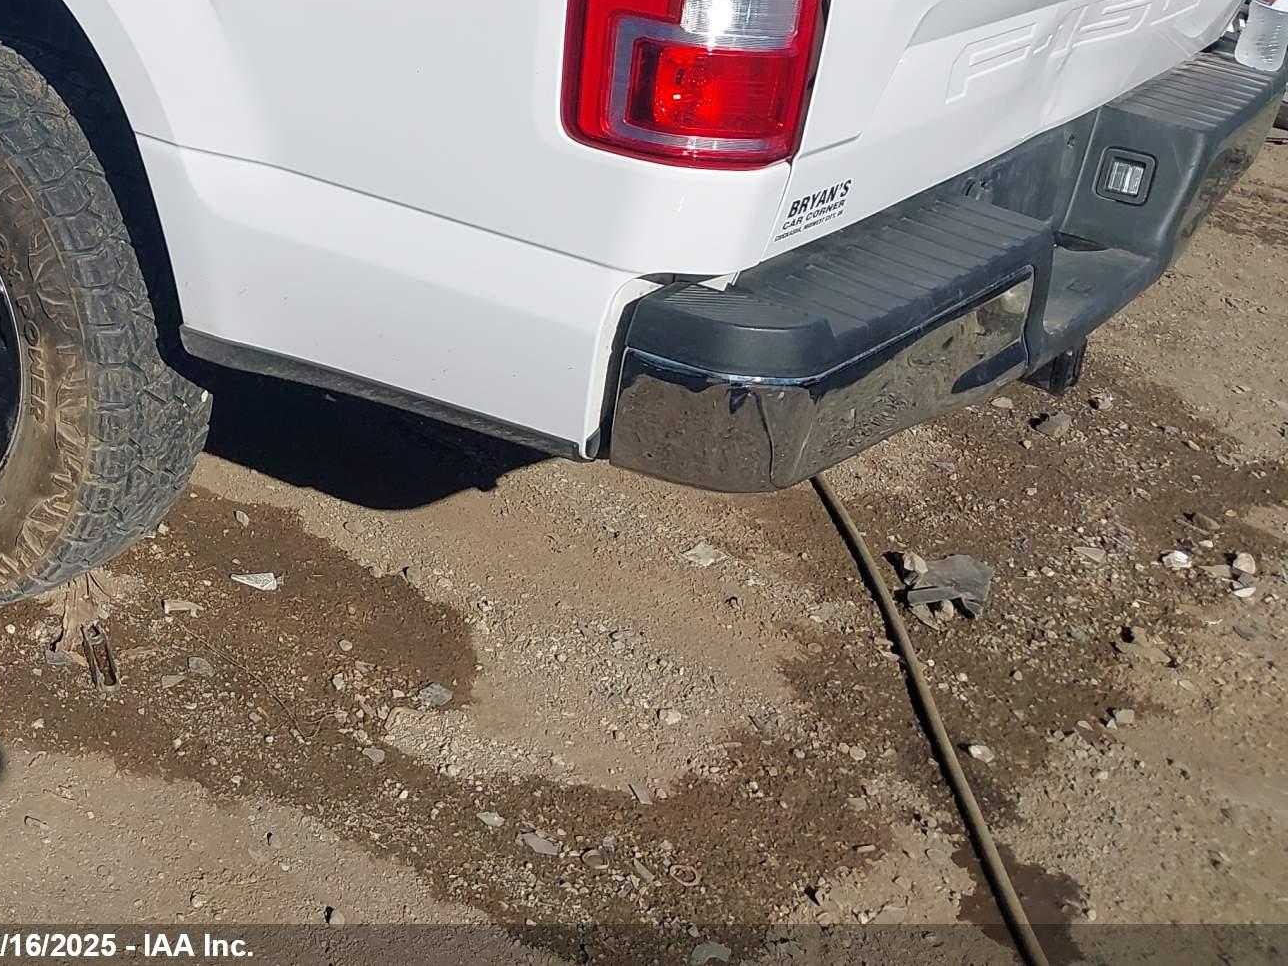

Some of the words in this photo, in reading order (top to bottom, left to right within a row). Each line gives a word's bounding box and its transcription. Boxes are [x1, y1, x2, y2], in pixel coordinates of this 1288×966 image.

[782, 216, 803, 230] CAR
[805, 199, 845, 221] CORNER
[787, 179, 852, 218] BRYAN'S
[16, 294, 47, 425] POWER
